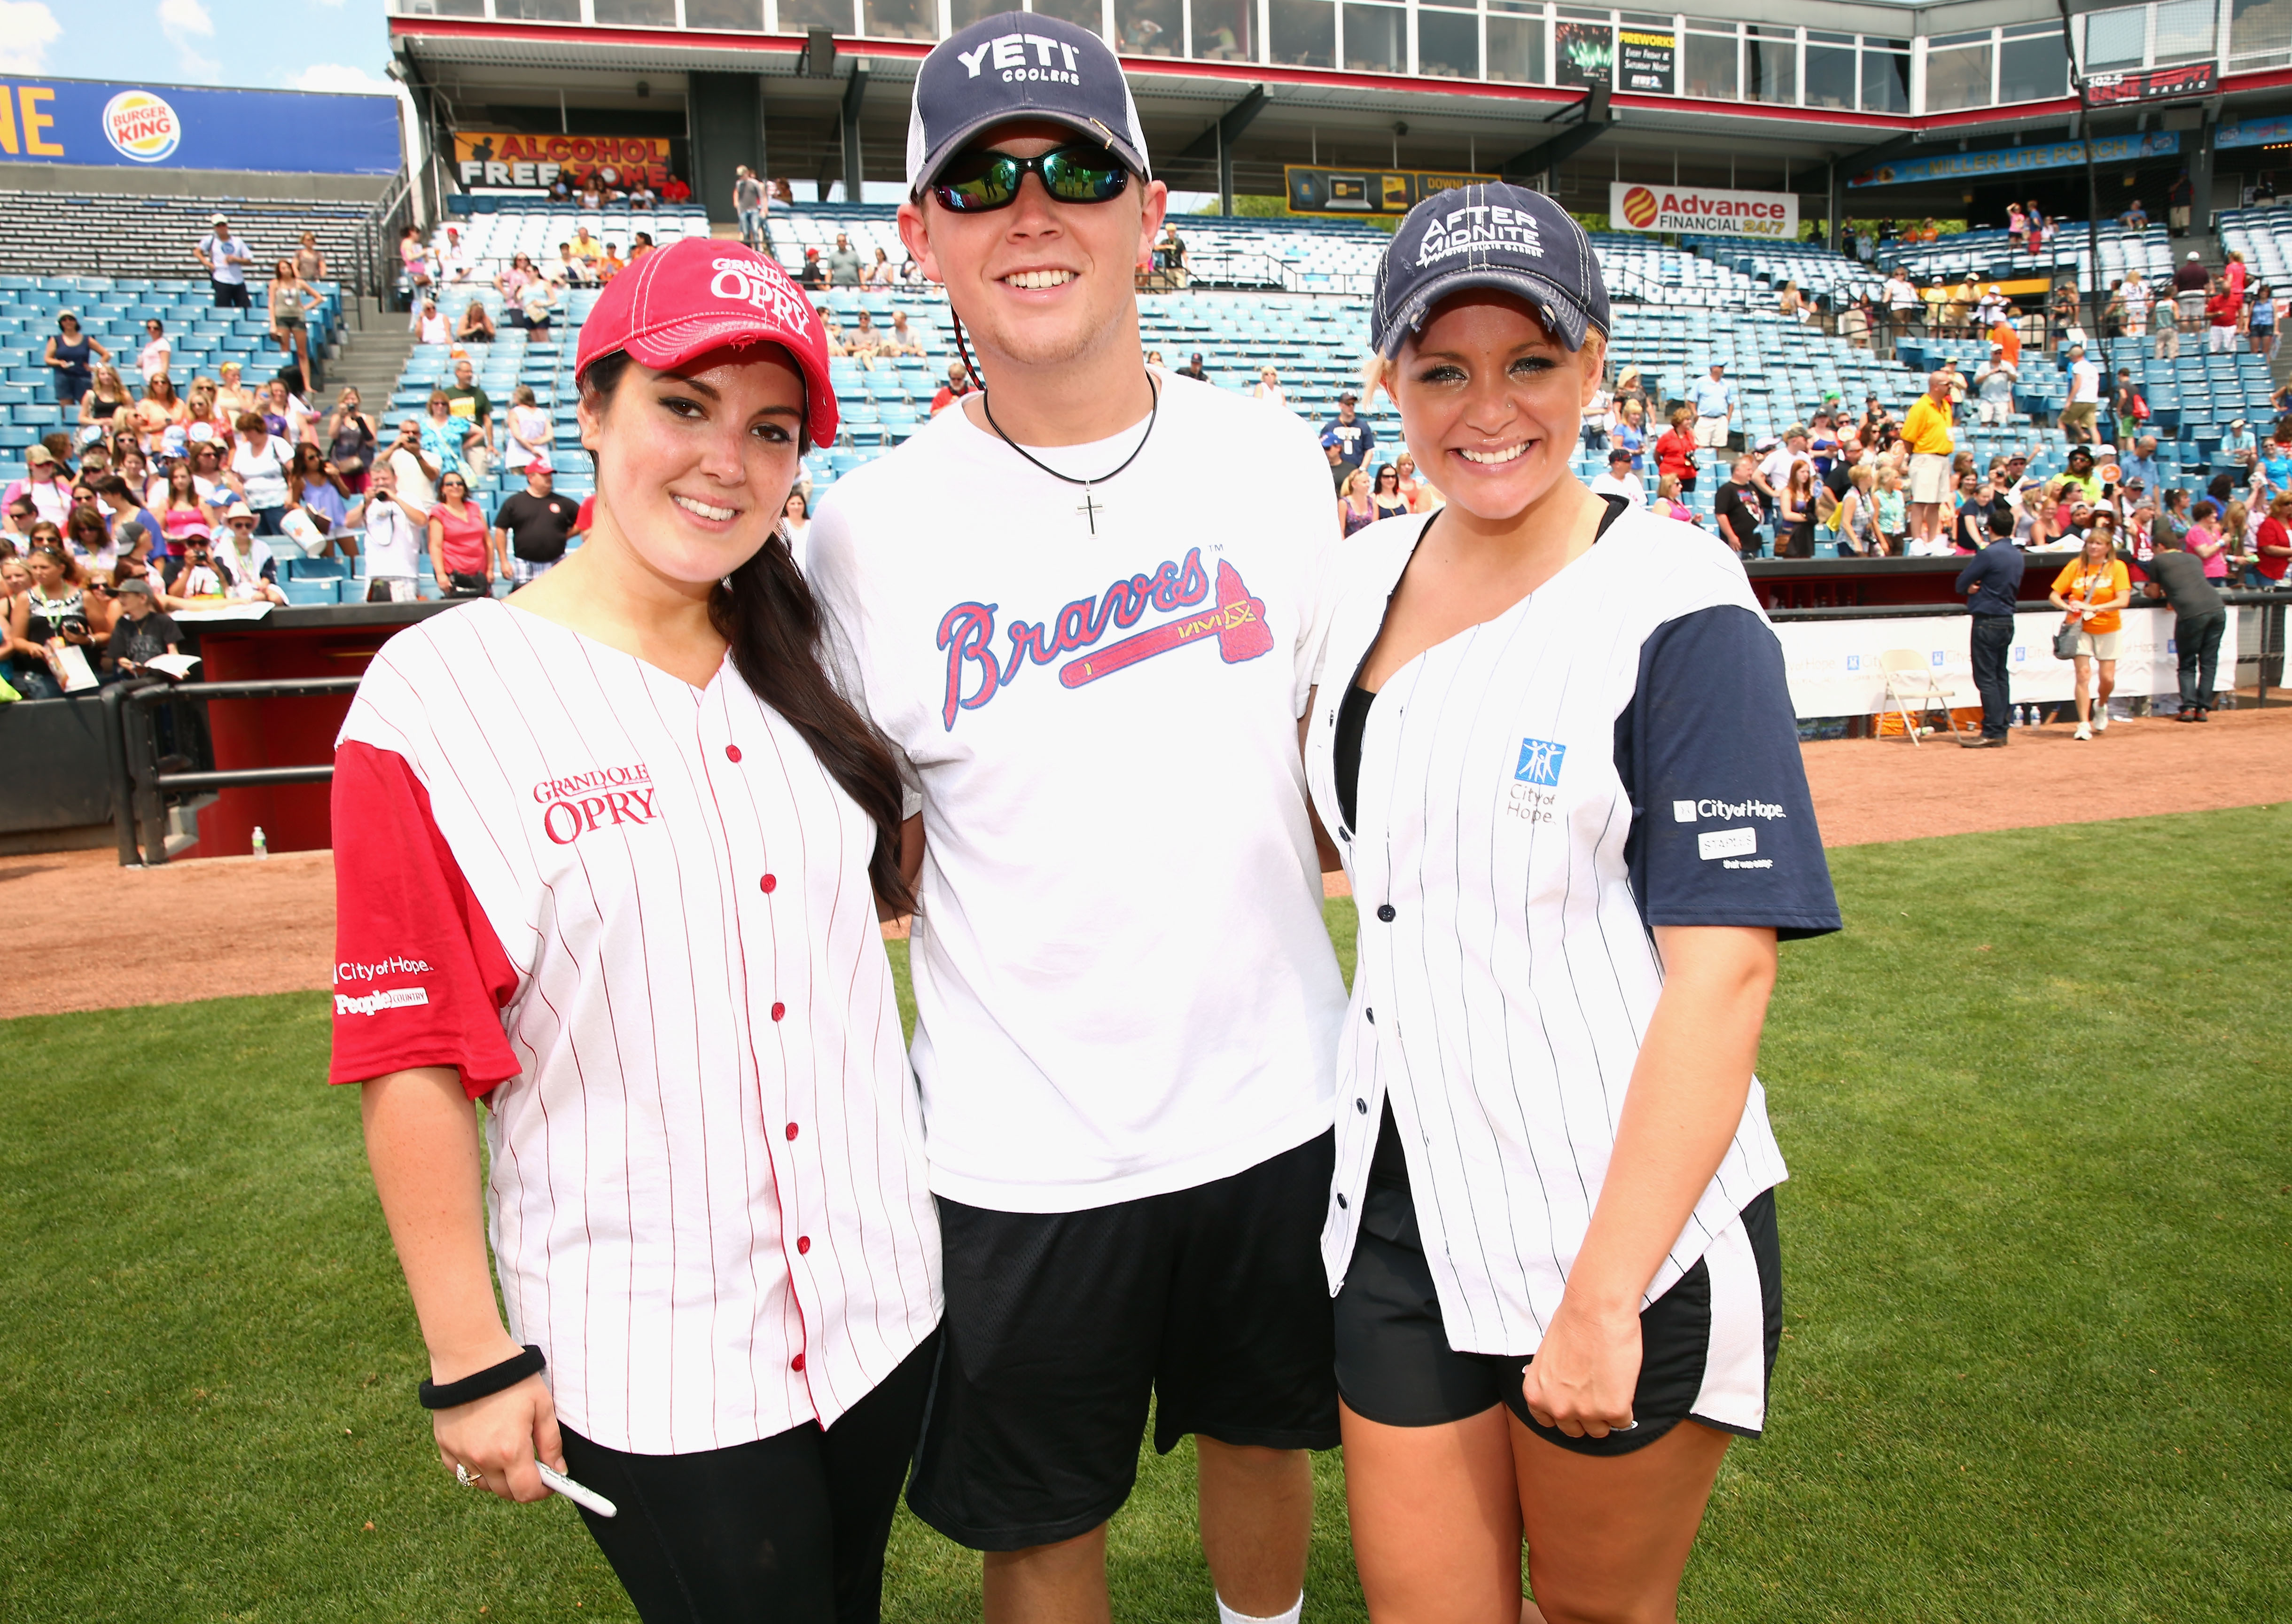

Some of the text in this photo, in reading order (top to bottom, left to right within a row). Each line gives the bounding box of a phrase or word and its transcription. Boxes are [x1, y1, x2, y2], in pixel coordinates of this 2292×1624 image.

[1619, 31, 1675, 48] FIREWORKS
[958, 33, 1078, 78] YETI
[1002, 68, 1079, 86] COOLERS
[2088, 74, 2123, 88] 102.5
[2149, 80, 2206, 95] RADIO
[2150, 65, 2211, 86] ESPN
[2088, 76, 2141, 102] GAME
[113, 106, 167, 127] BURGER
[118, 118, 171, 146] KING
[499, 137, 666, 163] ALCOHOL
[1929, 154, 1999, 175] MILLER
[2005, 146, 2048, 167] LITE
[460, 160, 668, 187] FREE ZONE
[1661, 194, 1785, 219] Advance
[1422, 205, 1537, 242] AFTER
[1660, 215, 1785, 234] FINANCIAL 24/7
[1419, 223, 1541, 258] MIDNITE
[711, 258, 781, 284] GRAND
[710, 269, 810, 340] OPRY
[936, 547, 1209, 733] Braves
[533, 764, 650, 804] GRAND OLE
[1511, 784, 1556, 807] City of
[544, 788, 656, 845] OPRY
[1507, 801, 1552, 825] Hope
[1698, 799, 1734, 820] City
[1734, 803, 1747, 817] of
[338, 962, 374, 981] City
[375, 960, 389, 975] of
[334, 989, 424, 1016] People COUNTRY
